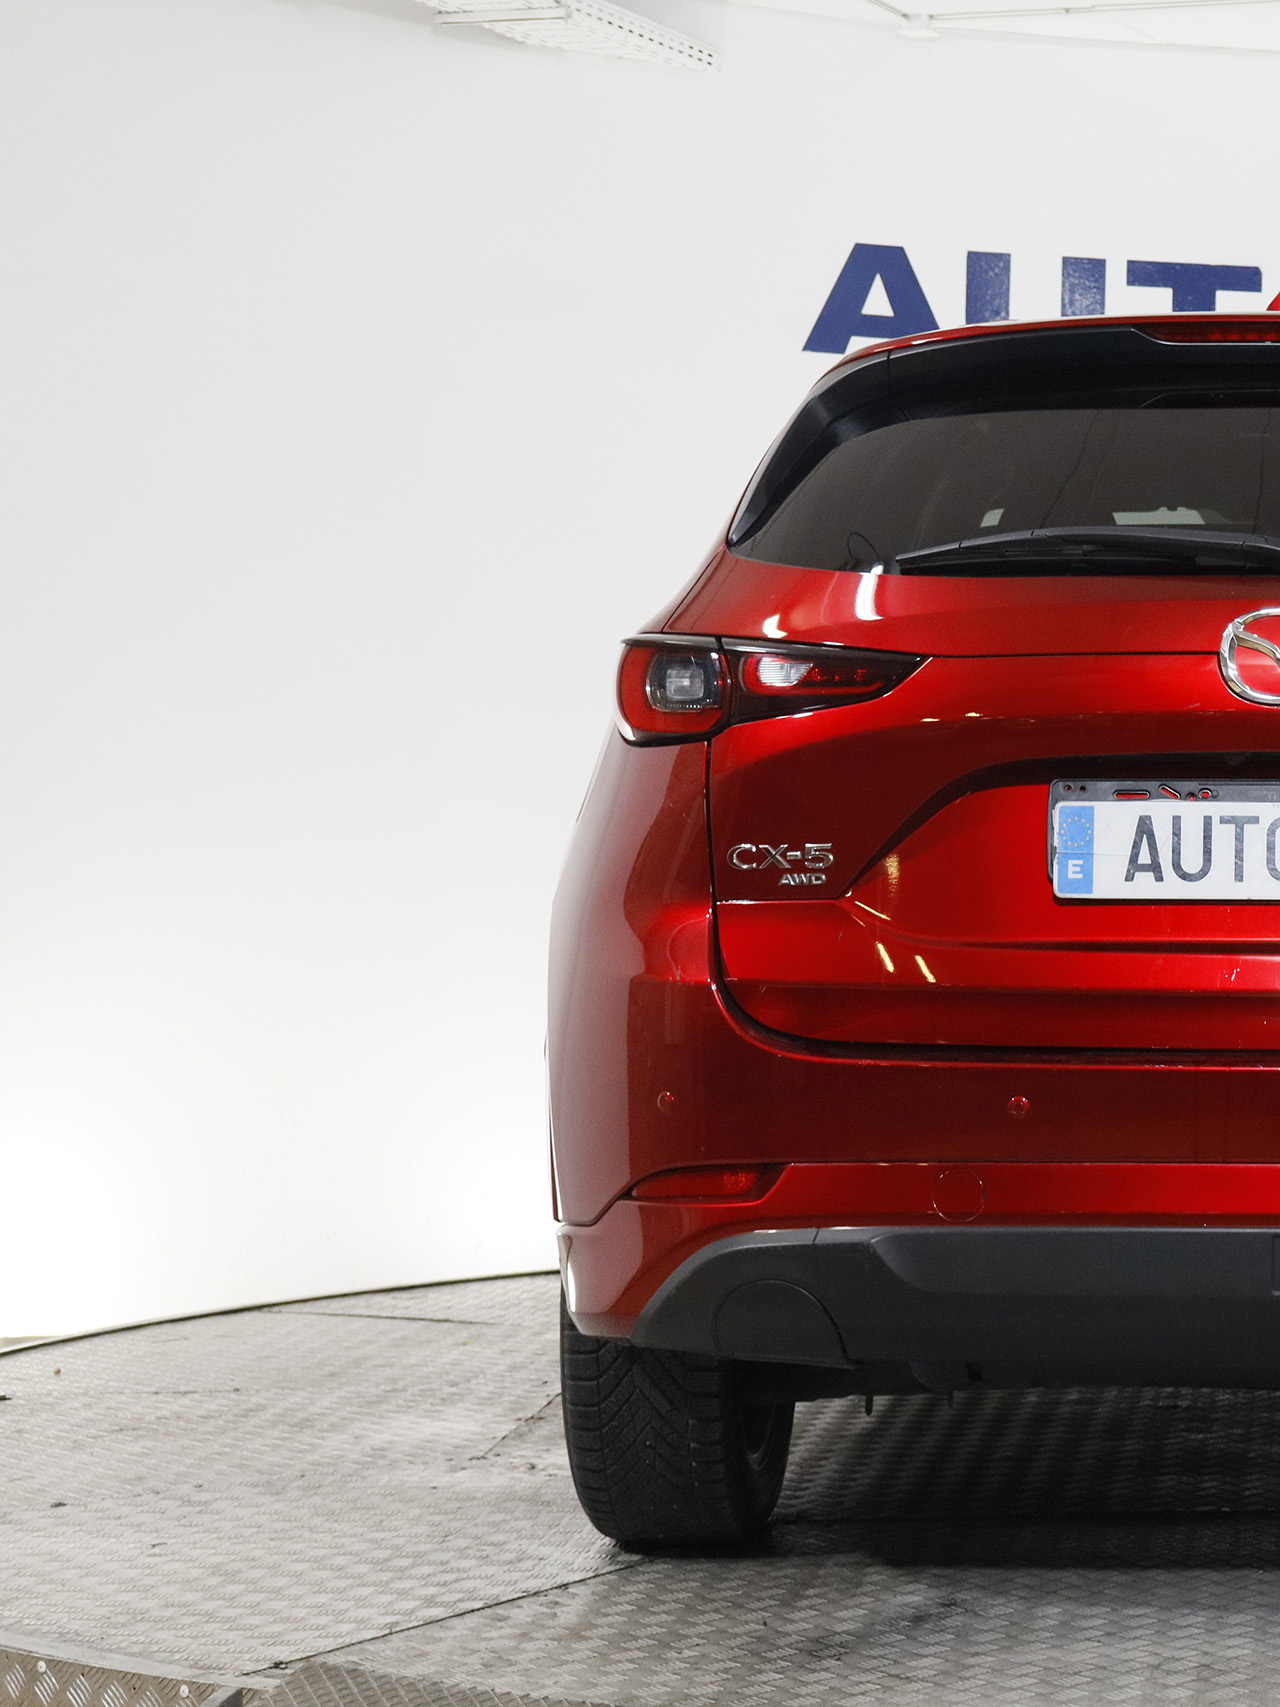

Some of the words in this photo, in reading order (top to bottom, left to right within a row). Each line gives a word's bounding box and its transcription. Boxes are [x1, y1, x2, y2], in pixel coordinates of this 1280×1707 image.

[726, 843, 834, 870] CX-5
[1067, 859, 1084, 879] E
[778, 873, 827, 886] AWD
